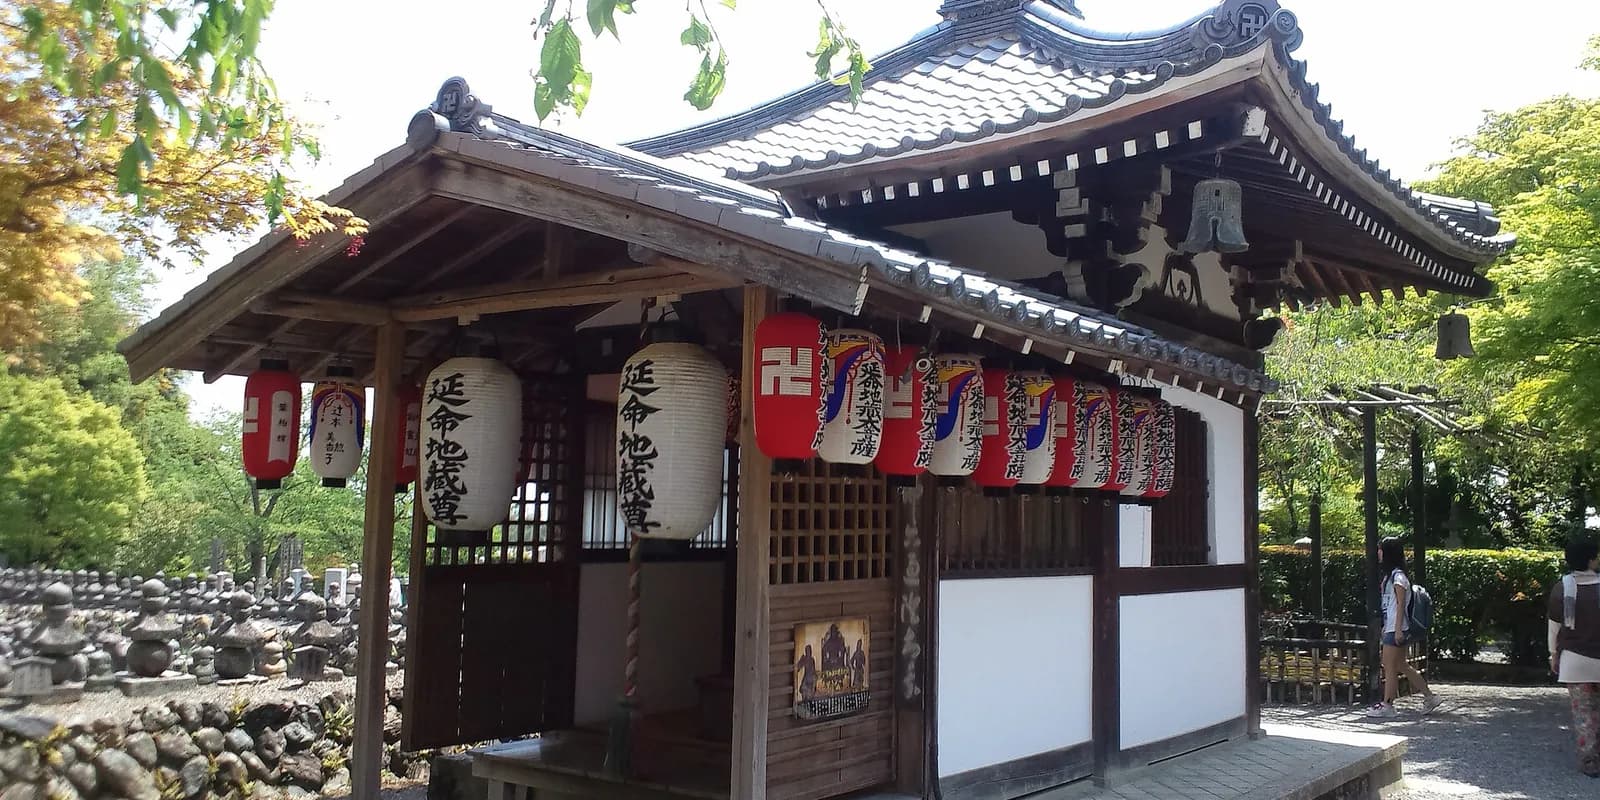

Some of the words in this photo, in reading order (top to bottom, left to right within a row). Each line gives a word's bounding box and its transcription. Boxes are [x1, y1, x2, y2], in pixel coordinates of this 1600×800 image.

[425, 373, 472, 526] 延命地蔵尊
[619, 359, 662, 534] 延命地蔵尊
